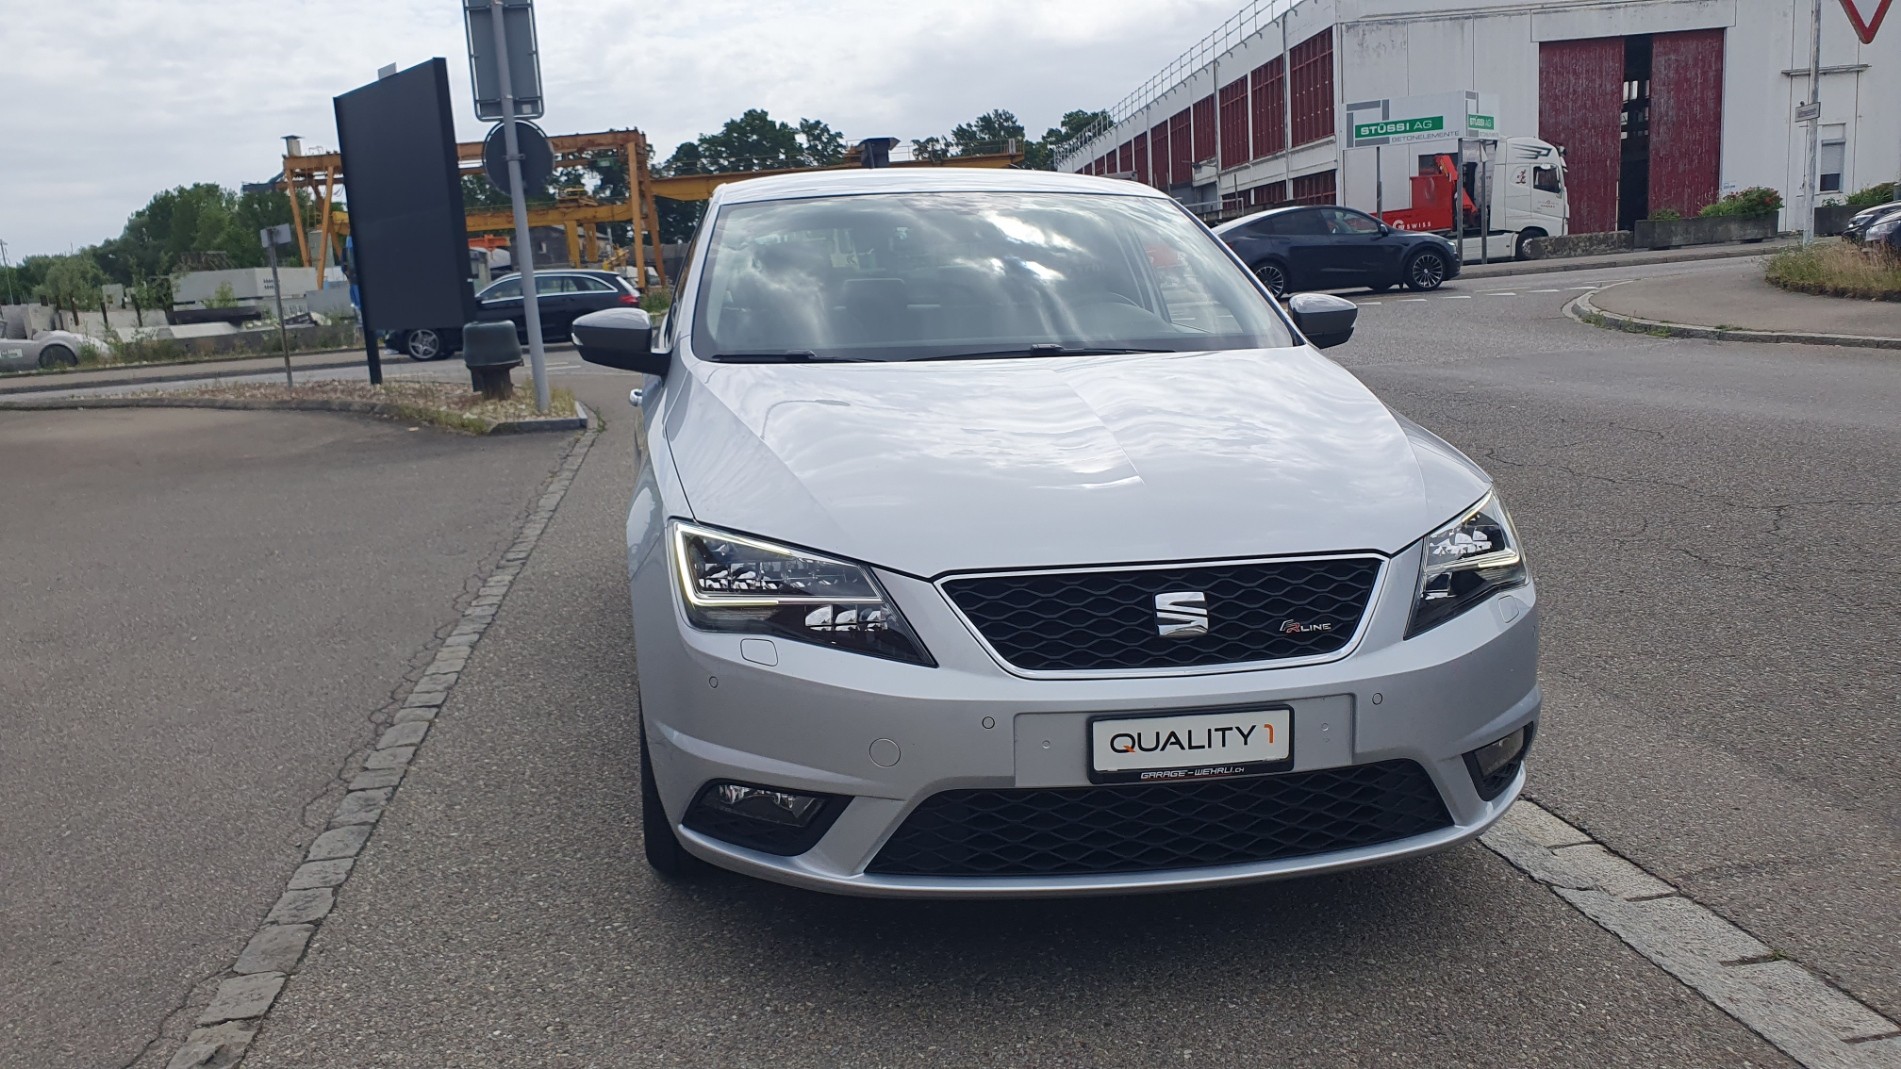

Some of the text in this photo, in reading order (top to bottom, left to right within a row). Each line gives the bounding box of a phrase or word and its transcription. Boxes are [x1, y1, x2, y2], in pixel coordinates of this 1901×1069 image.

[1360, 120, 1433, 135] STÜSSI AG
[1391, 130, 1460, 142] BETONELEMENTE
[1300, 623, 1331, 632] LINE
[1109, 723, 1274, 753] QUALITY 1
